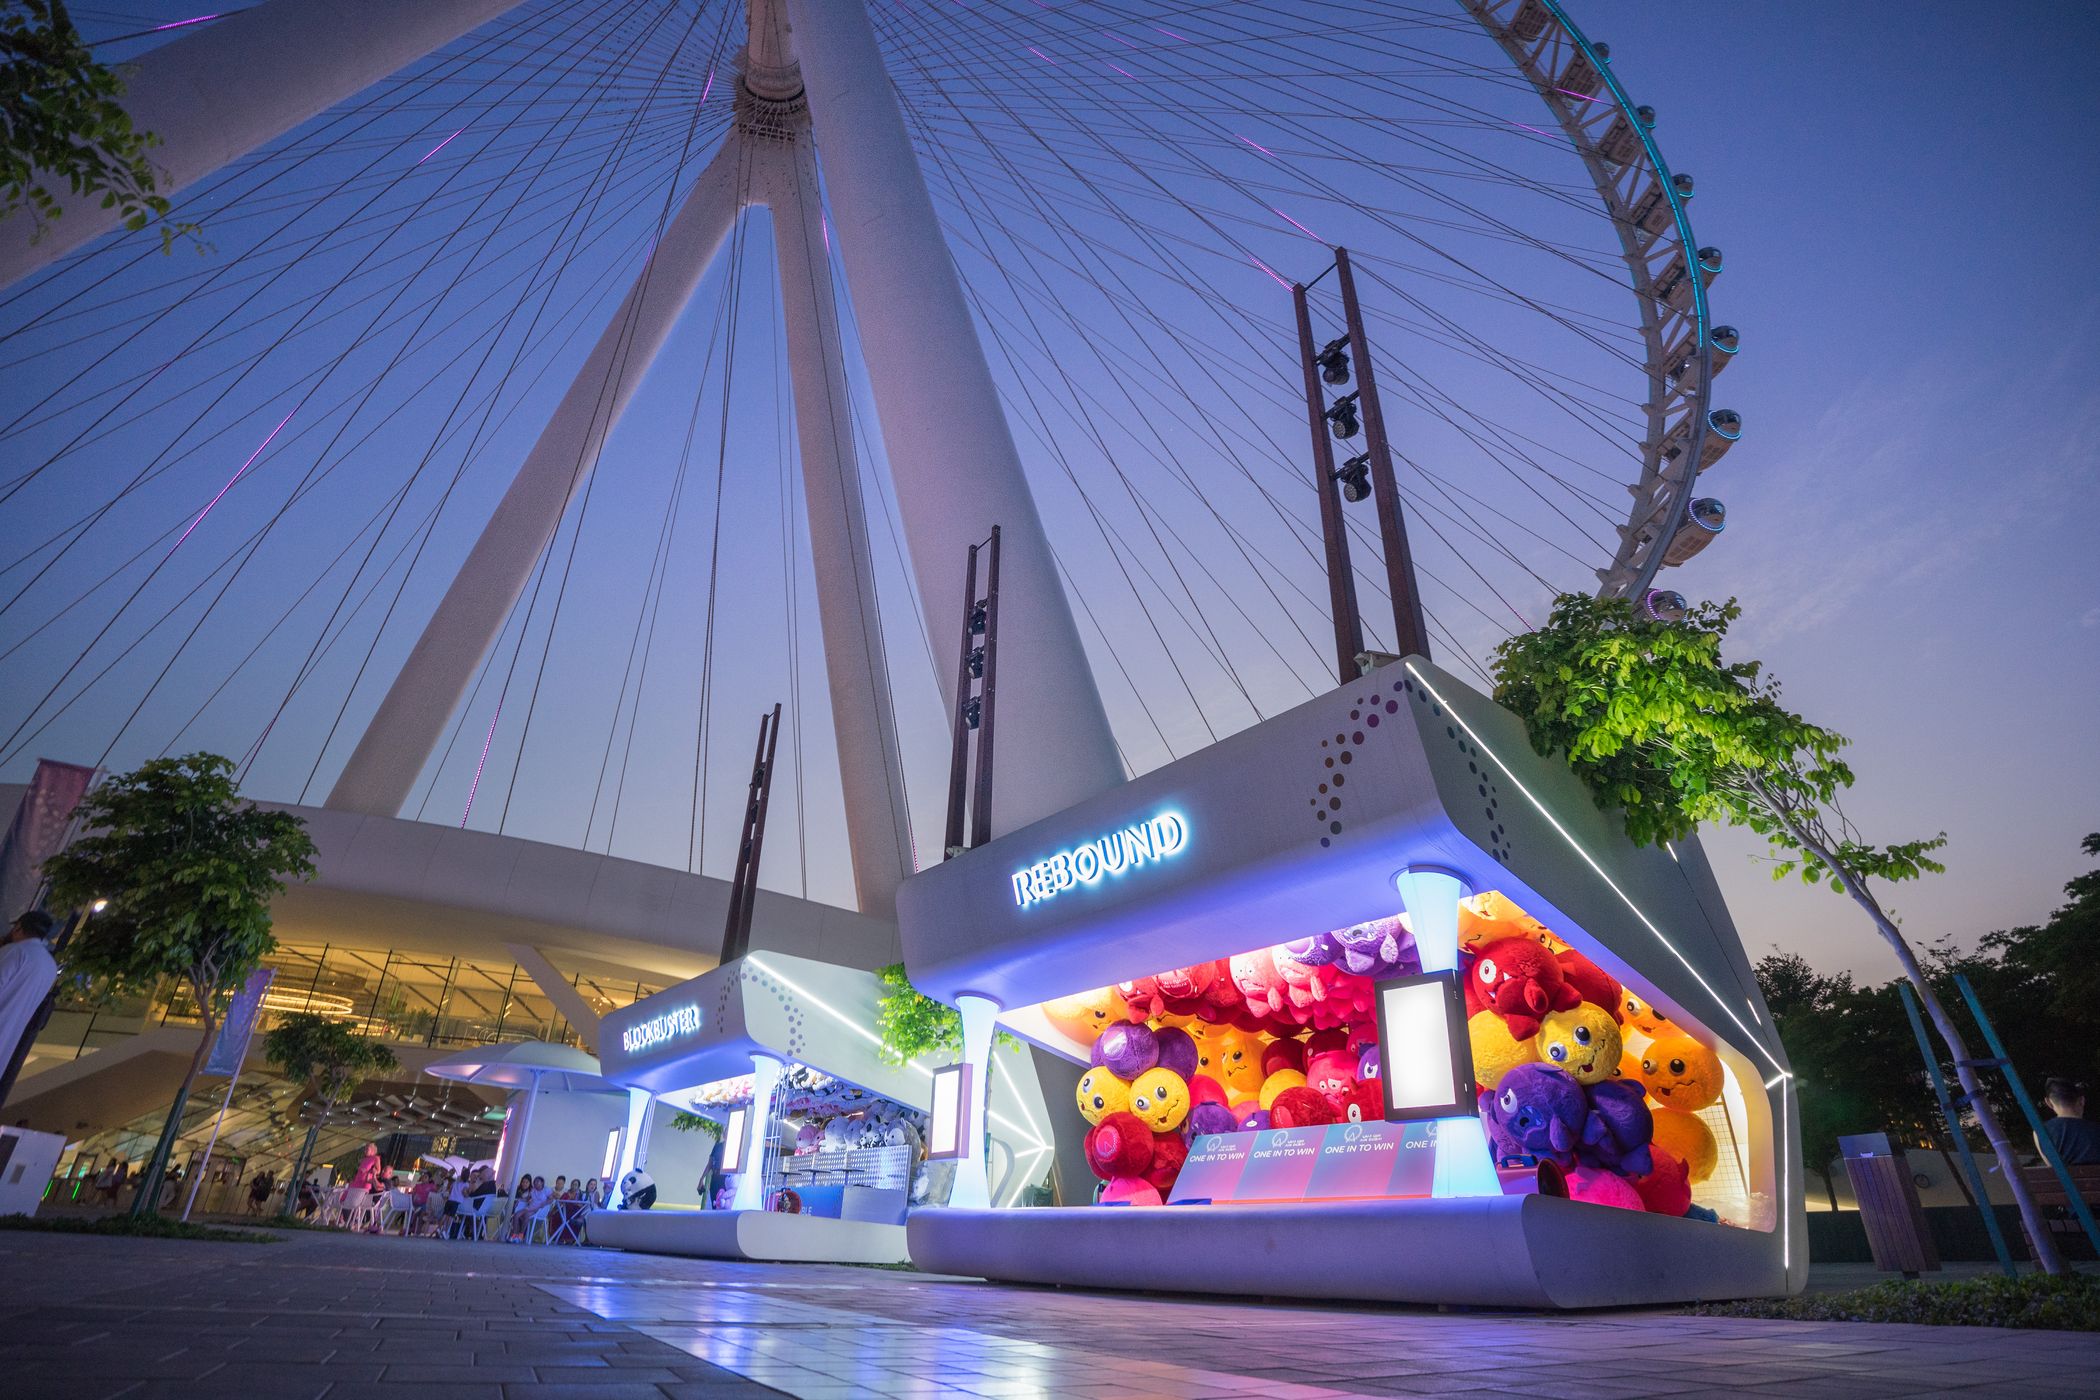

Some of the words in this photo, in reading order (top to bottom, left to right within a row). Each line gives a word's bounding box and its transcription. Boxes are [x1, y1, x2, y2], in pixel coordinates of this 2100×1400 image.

[1012, 813, 1188, 906] REBOUND
[623, 1004, 701, 1052] BLOCKBUSTER
[1325, 1145, 1345, 1154] ONE
[1346, 1144, 1357, 1153] IN
[1359, 1143, 1372, 1152] TO
[1374, 1142, 1394, 1151] WIN
[1405, 1140, 1428, 1149] ONE
[1189, 1154, 1206, 1163] ONE
[1206, 1153, 1216, 1161] IN
[1216, 1153, 1227, 1161] TO
[1228, 1152, 1245, 1161] WIN
[1253, 1150, 1272, 1159] ONE
[1284, 1148, 1295, 1157] TO
[1296, 1147, 1315, 1156] WIN
